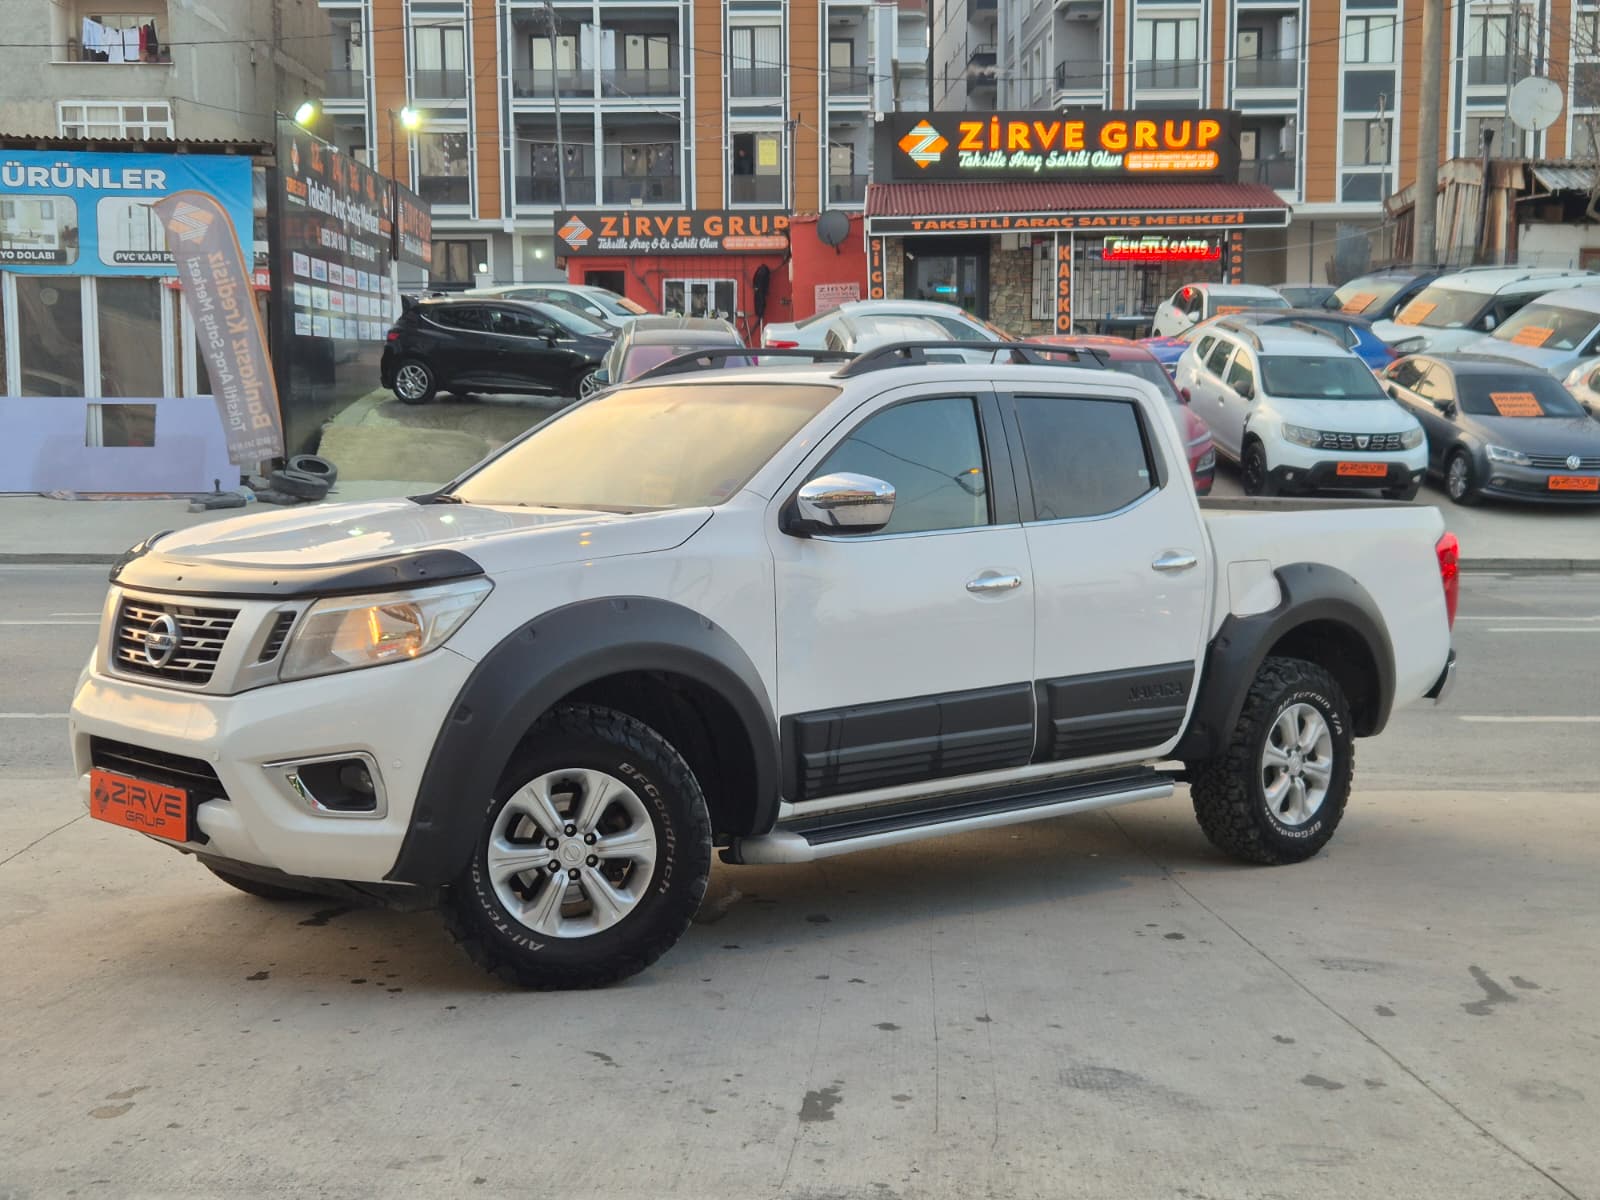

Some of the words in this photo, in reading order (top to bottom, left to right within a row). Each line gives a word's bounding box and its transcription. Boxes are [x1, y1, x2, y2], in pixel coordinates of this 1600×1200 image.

[958, 115, 1085, 150] ZİRVE
[1100, 120, 1221, 149] GRUP
[958, 151, 1007, 168] Taksitle
[1008, 151, 1042, 172] Araç
[1046, 150, 1091, 168] Sahibi
[1092, 150, 1123, 168] Olun
[1, 161, 168, 190] ÜRÜNLER
[600, 212, 691, 236] ZİRVE
[703, 215, 790, 236] GRUP
[912, 217, 1009, 230] TAKSİTLİ
[1014, 217, 1074, 229] ARAÇ
[1078, 216, 1142, 227] SATIŞ
[1146, 213, 1244, 225] MERKEZİ
[16, 251, 55, 260] DOLABI
[597, 237, 628, 250] Taksitle
[629, 238, 650, 252] Araç
[671, 237, 698, 250] Sahibi
[699, 237, 719, 250] Olun
[116, 253, 136, 262] PVC
[138, 253, 163, 262] KAPI
[1057, 245, 1071, 331] KASKO
[1331, 712, 1343, 735] T/A
[125, 809, 167, 829] GRUP
[618, 762, 676, 894] BFGoodrich
